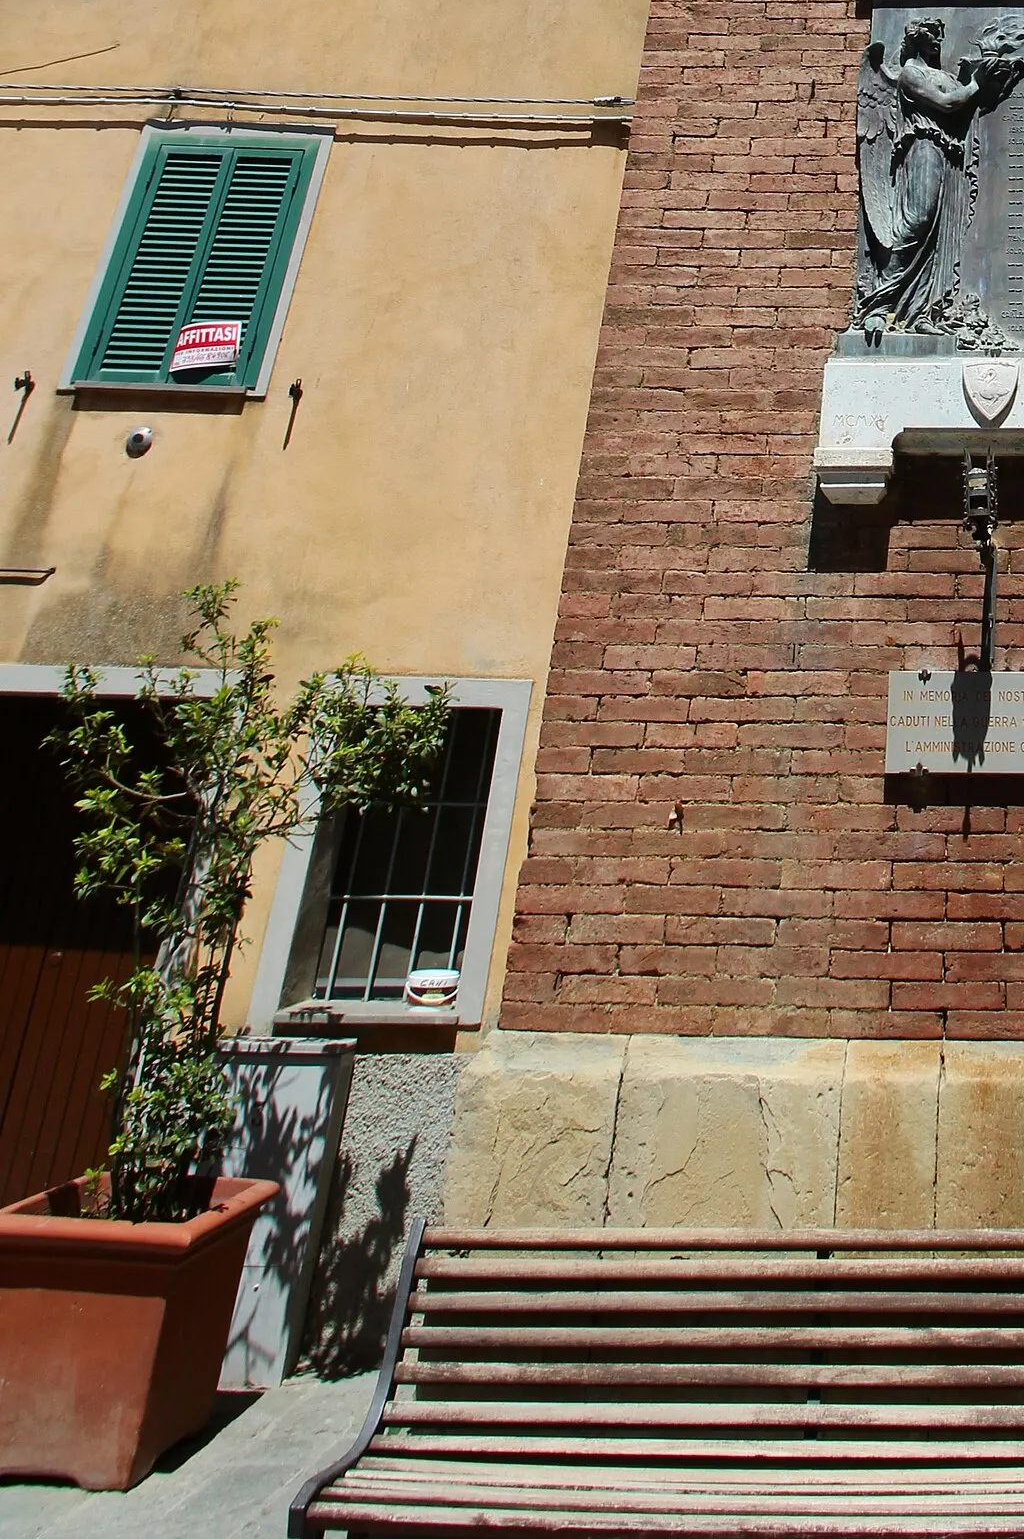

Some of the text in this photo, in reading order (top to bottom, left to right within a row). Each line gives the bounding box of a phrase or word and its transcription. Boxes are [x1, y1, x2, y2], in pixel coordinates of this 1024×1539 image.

[176, 327, 237, 348] AFFITTASI
[903, 690, 914, 701] IN
[920, 690, 968, 701] MEMORIA
[976, 690, 992, 701] DEI
[889, 715, 930, 727] CADUTI
[934, 715, 968, 727] NELLA
[973, 716, 1017, 727] GUERRA
[905, 740, 1015, 753] L'AMMINISTRAZIONE
